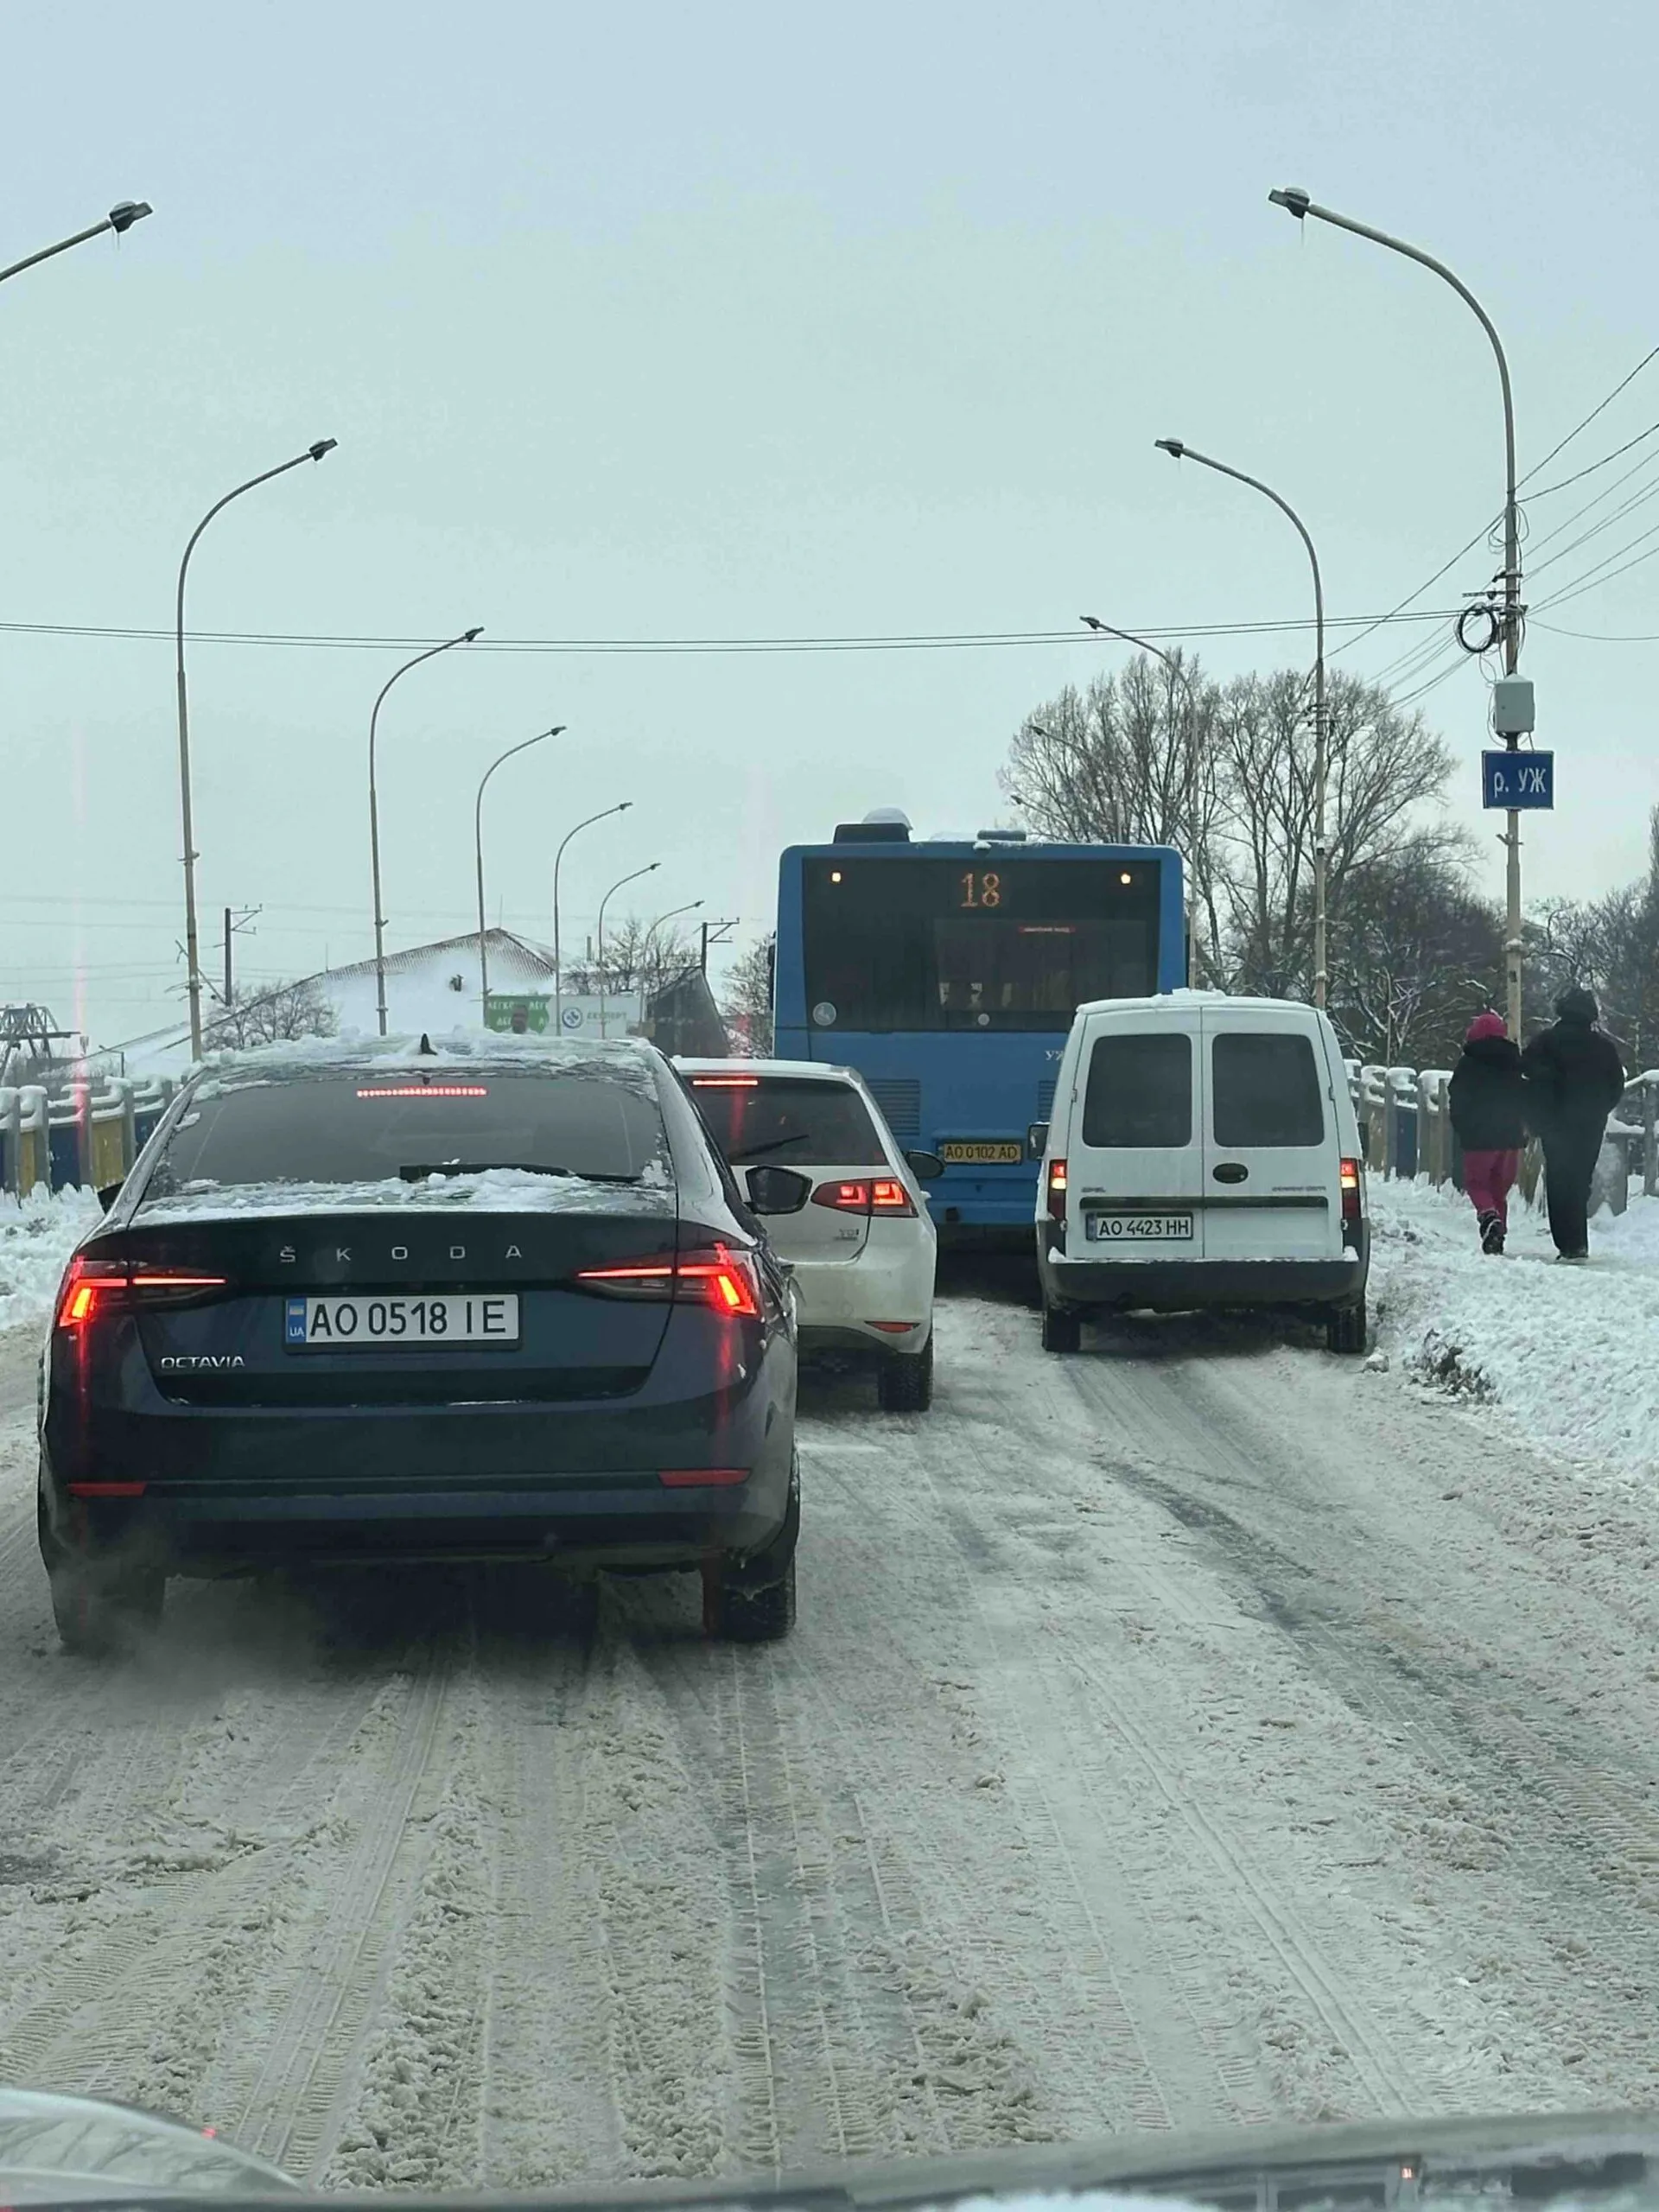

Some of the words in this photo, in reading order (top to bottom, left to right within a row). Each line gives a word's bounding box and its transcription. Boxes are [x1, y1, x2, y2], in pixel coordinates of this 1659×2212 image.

[1494, 772, 1510, 798] р.
[1518, 767, 1546, 792] УЖ
[961, 873, 1001, 906] 18
[945, 1146, 963, 1159] AO
[966, 1146, 995, 1159] 0102
[1098, 1220, 1122, 1236] AO
[1126, 1219, 1162, 1236] 4423
[1166, 1219, 1189, 1236] HH
[280, 1245, 522, 1262] ŠKODA
[309, 1303, 359, 1337] AO
[368, 1301, 448, 1335] 0518
[466, 1300, 506, 1334] IE
[289, 1326, 305, 1338] UA
[161, 1356, 245, 1368] OCTAVIA
